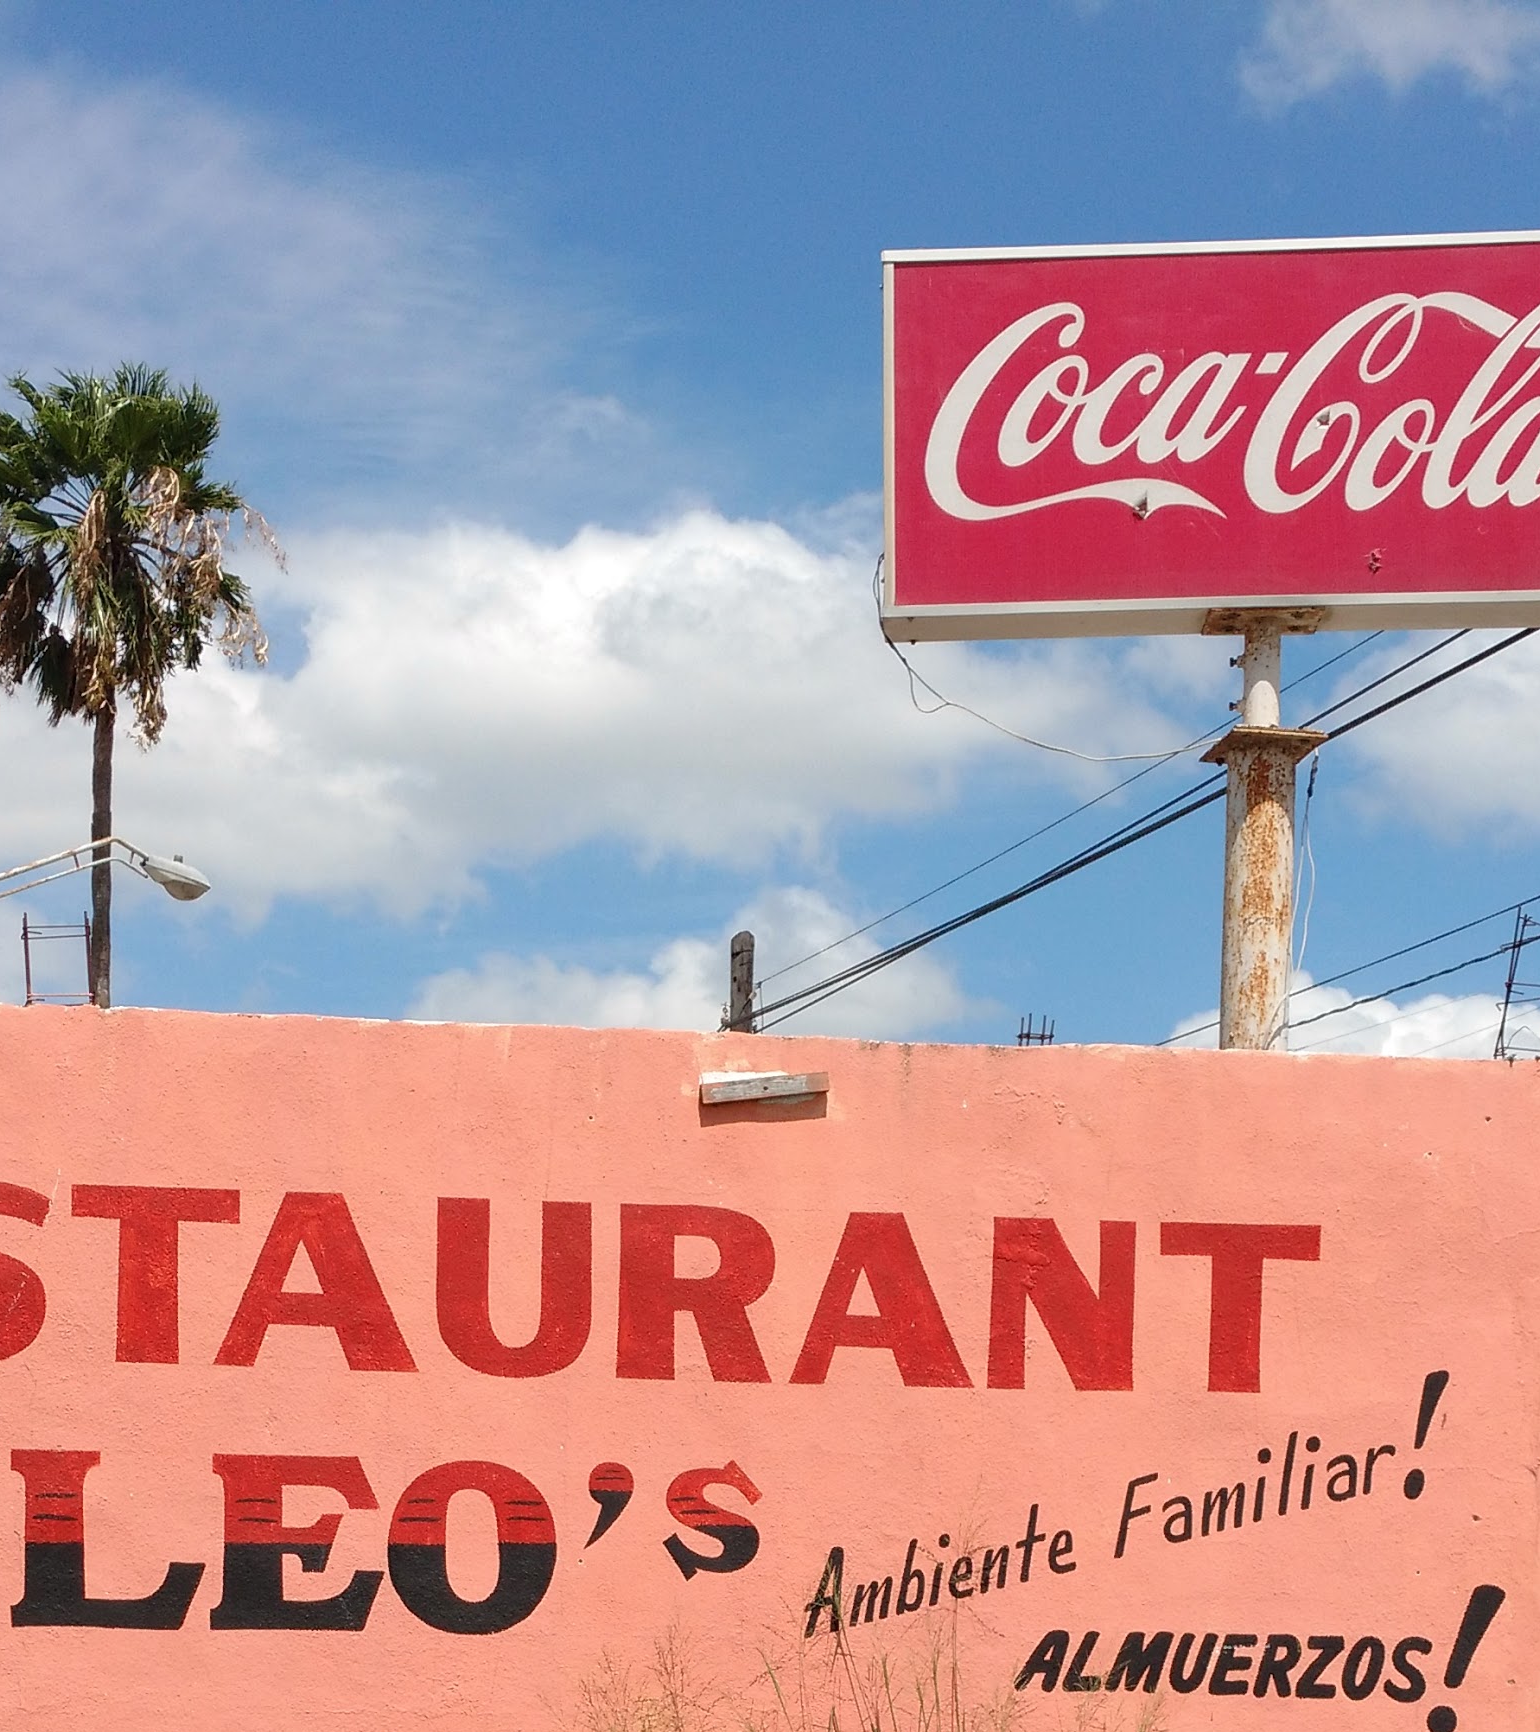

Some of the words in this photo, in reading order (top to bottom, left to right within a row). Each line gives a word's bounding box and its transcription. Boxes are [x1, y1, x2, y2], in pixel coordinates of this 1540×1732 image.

[10, 1449, 762, 1635] LEO'S
[805, 1504, 1076, 1639] Ambiente
[1114, 1370, 1449, 1558] Familiar!
